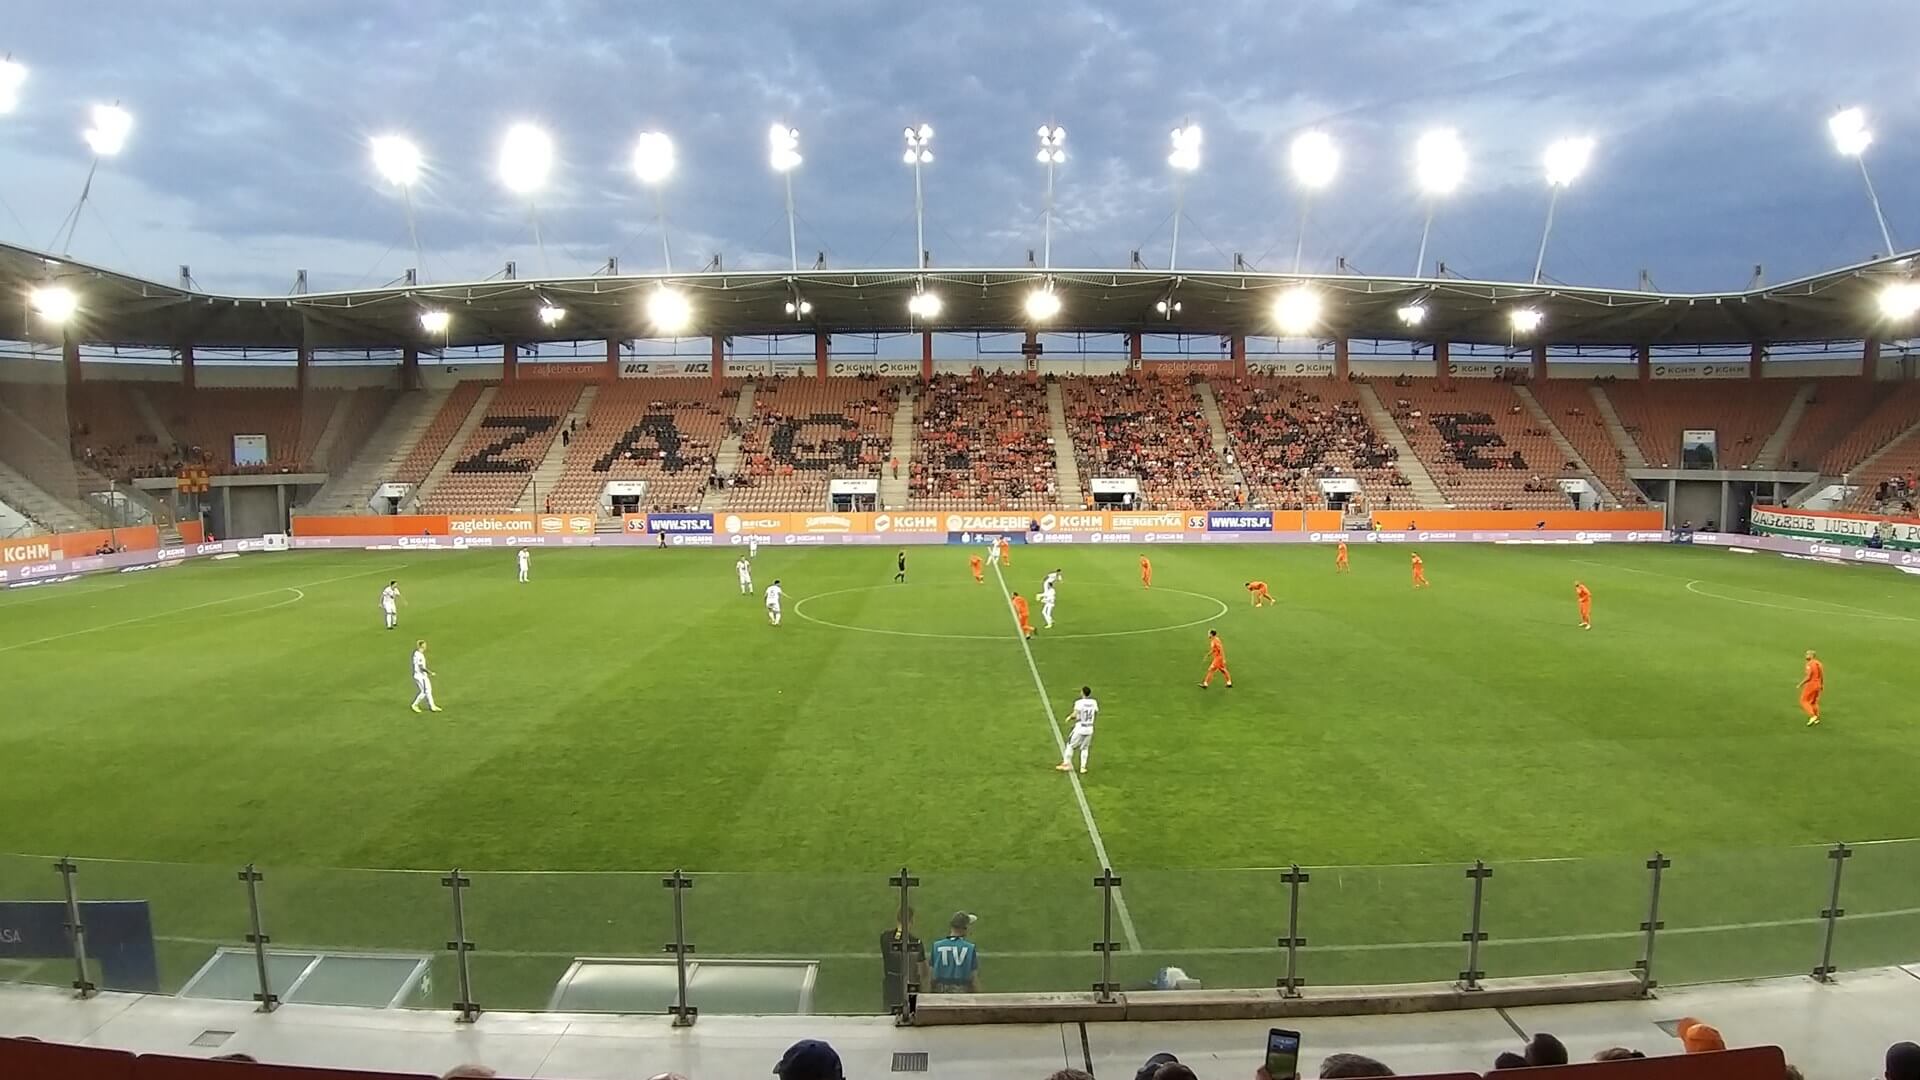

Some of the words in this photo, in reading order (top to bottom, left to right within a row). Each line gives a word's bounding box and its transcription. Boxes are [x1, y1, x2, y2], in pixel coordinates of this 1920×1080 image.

[451, 518, 532, 533] zaglebie.com
[651, 519, 712, 530] WWW.STS.PL
[894, 516, 937, 527] KGHM
[1060, 516, 1103, 527] KGHM
[1211, 517, 1272, 527] WWW.STS.PL
[1825, 518, 1868, 534] LUBIN
[4, 544, 49, 562] KGHM
[937, 946, 968, 966] TV
